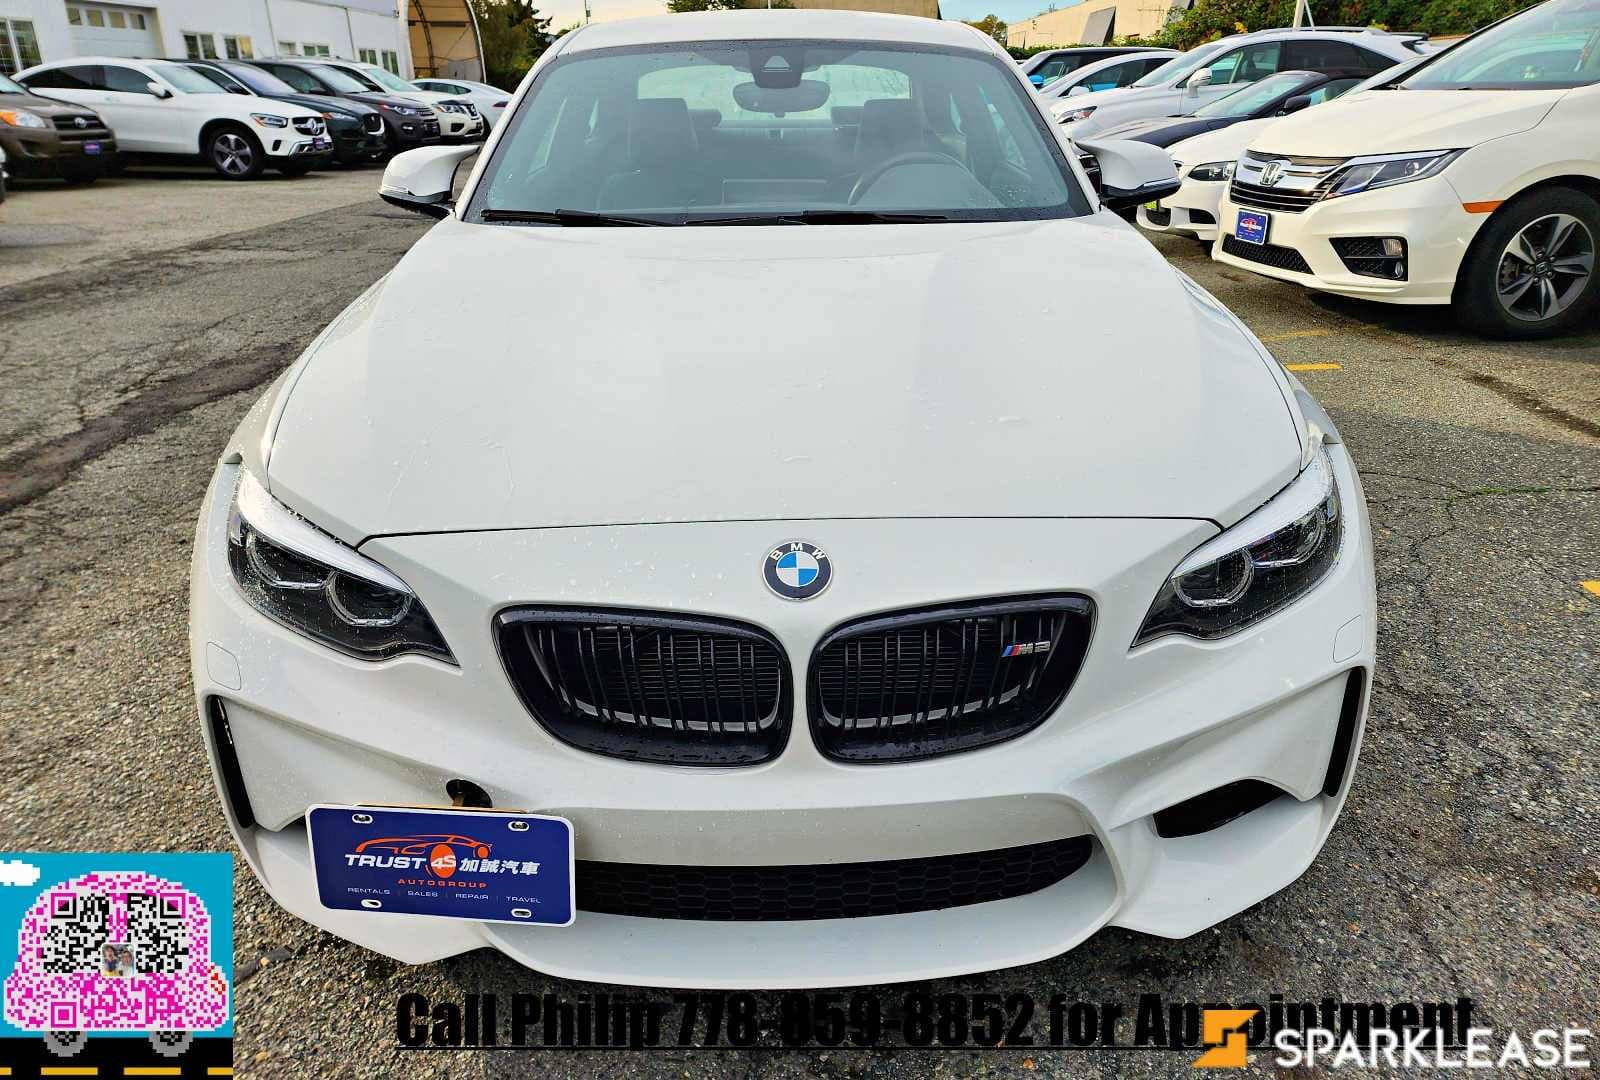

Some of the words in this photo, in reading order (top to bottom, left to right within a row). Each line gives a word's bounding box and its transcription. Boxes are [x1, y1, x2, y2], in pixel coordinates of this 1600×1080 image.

[770, 543, 826, 560] BMW
[345, 853, 427, 870] TRUST
[431, 855, 456, 869] 4S
[458, 857, 541, 876] 加誠汽車
[398, 878, 487, 889] AUTOGROUP
[347, 887, 391, 896] RENTALS
[407, 890, 439, 898] SALES
[455, 892, 490, 901] REPAIR
[506, 896, 542, 905] TRAVEL
